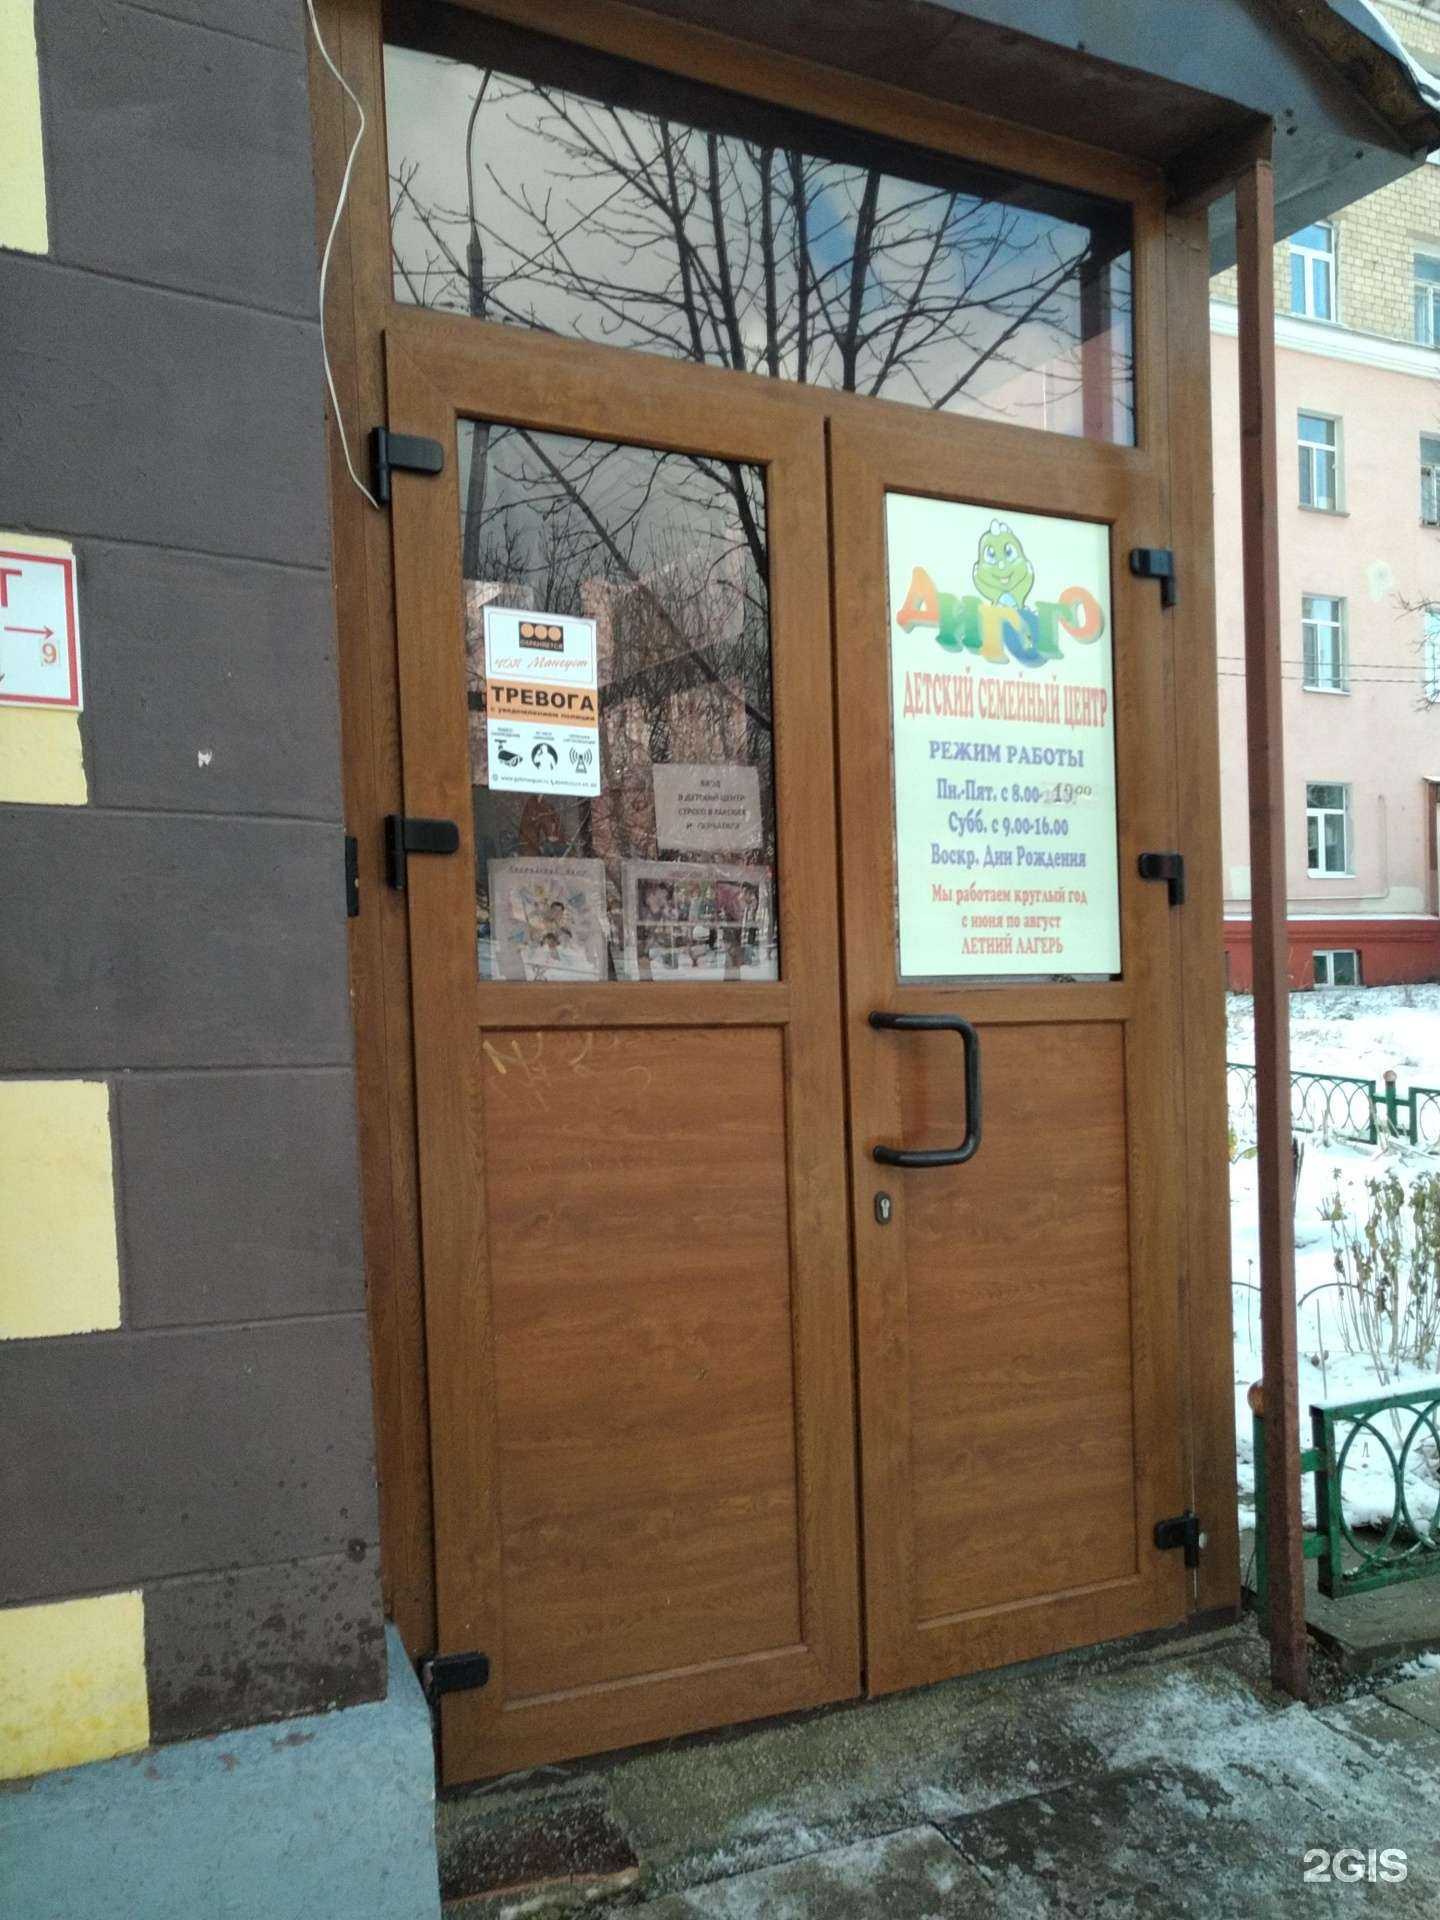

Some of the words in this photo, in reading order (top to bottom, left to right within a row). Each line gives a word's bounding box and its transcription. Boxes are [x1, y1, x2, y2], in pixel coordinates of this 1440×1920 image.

[42, 642, 57, 664] 9
[490, 686, 594, 711] ТРЕВОГА
[903, 666, 974, 719] ДЕТСКИЙ
[978, 671, 1060, 724] СЕМЕЙНЫЙ
[1063, 685, 1107, 730] ЦЕНТР
[929, 740, 1001, 763] РЕЖИМ
[1006, 746, 1084, 768] РАБОТЫ
[1001, 786, 1008, 801] с
[948, 808, 988, 837] Субб.
[992, 818, 999, 833] с
[1002, 817, 1069, 837] 9.00-16.00
[931, 843, 979, 869] Воскр.
[983, 845, 1012, 868] Дни
[1016, 846, 1087, 868] Рождения
[932, 883, 952, 902] Мы
[956, 881, 1011, 906] работаем
[1014, 886, 1065, 906] круглый
[1068, 890, 1089, 905] год
[961, 915, 968, 928] с
[971, 915, 1003, 928] июня
[1006, 916, 1021, 928] по
[1023, 916, 1061, 932] август
[961, 932, 1013, 954] ЛЕТНИЙ
[1016, 937, 1064, 954] ЛАГЕРЬ
